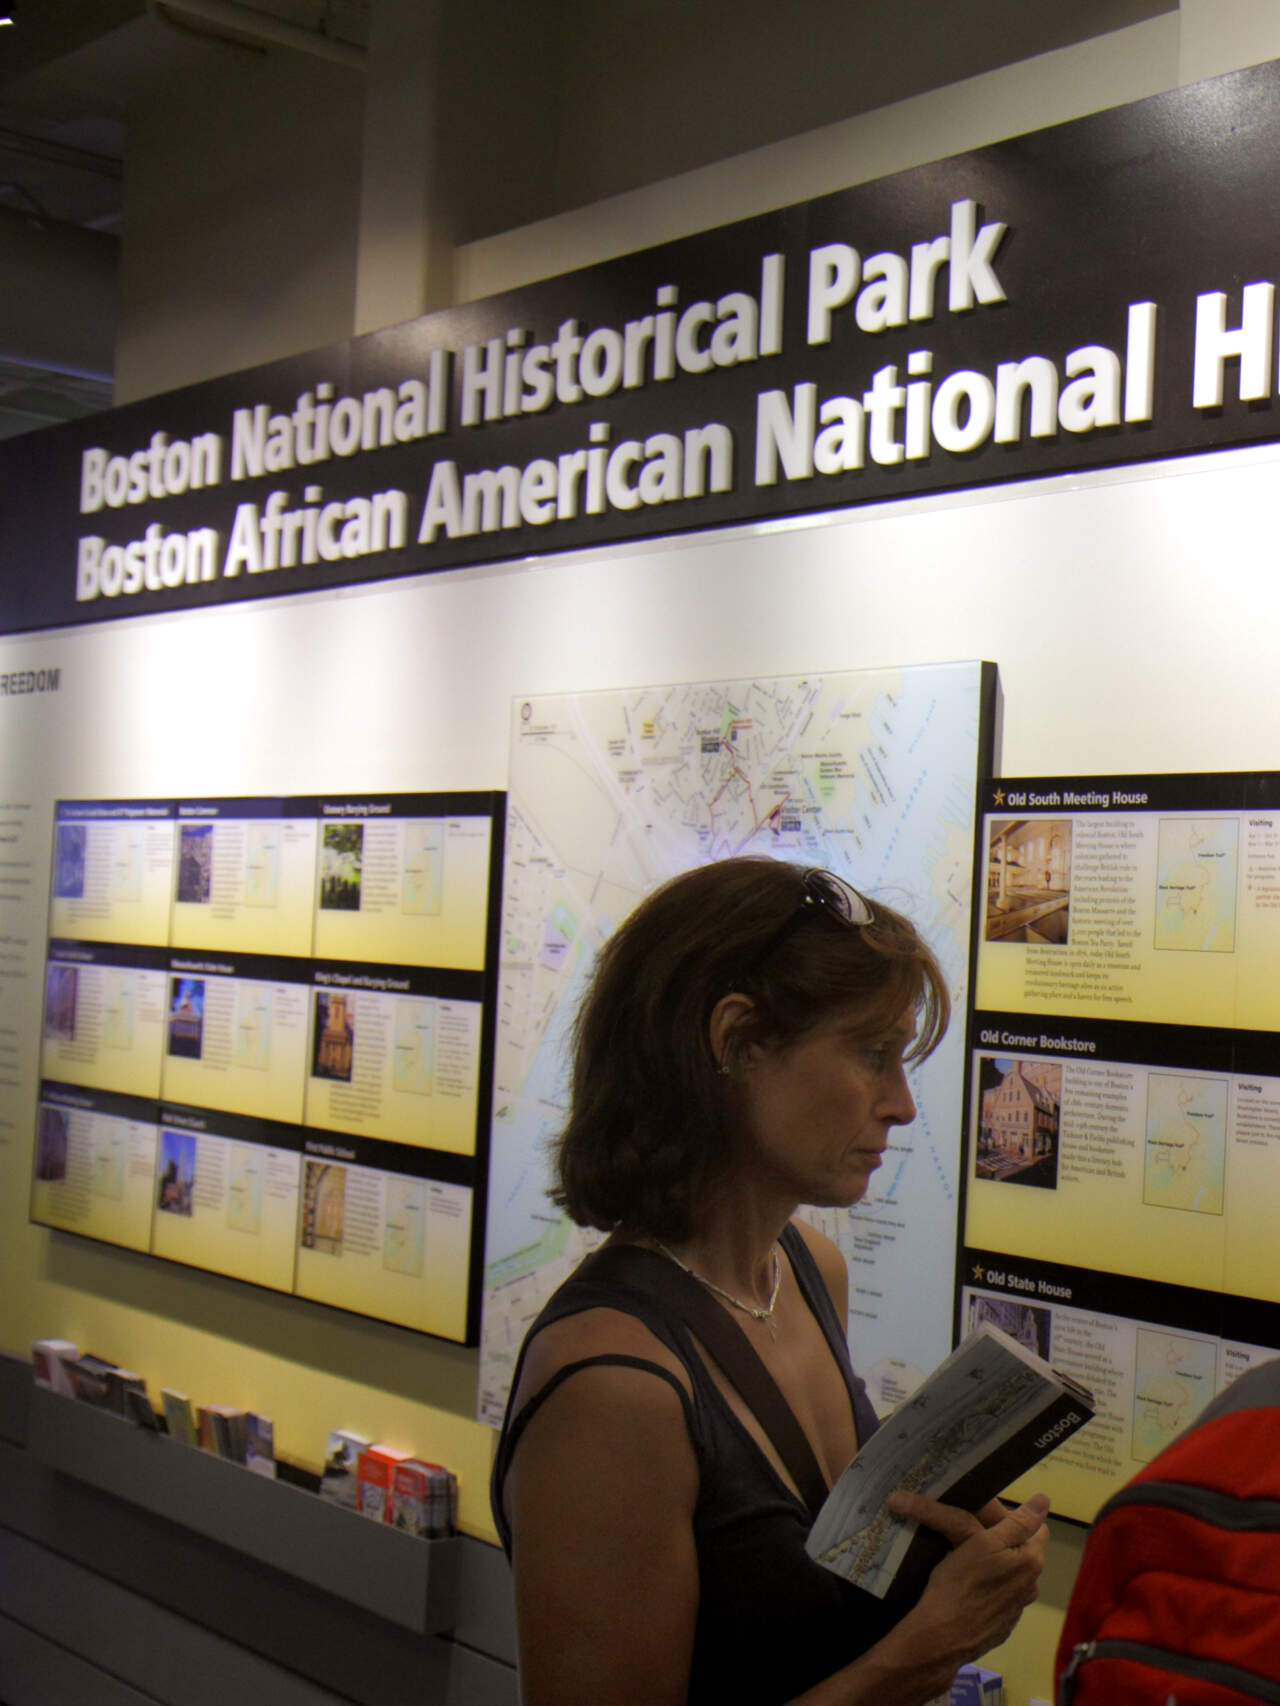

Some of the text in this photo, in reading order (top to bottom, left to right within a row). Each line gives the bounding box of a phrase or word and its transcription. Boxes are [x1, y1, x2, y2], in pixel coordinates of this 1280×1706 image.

[80, 199, 1008, 513] Boston National Historical Park
[76, 523, 217, 602] Boston
[224, 485, 408, 578] African
[418, 422, 734, 544] American
[754, 301, 1157, 486] National
[0, 669, 62, 694] REEDOM
[1007, 791, 1148, 807] Old South Meeting House
[1248, 819, 1273, 829] Visiting
[980, 1031, 1095, 1050] Old Corner Bookstore
[1238, 1082, 1263, 1094] Visiting
[986, 1272, 1071, 1296] Old State House
[1226, 1349, 1251, 1361] Visiting
[1034, 1411, 1081, 1449] Boston
